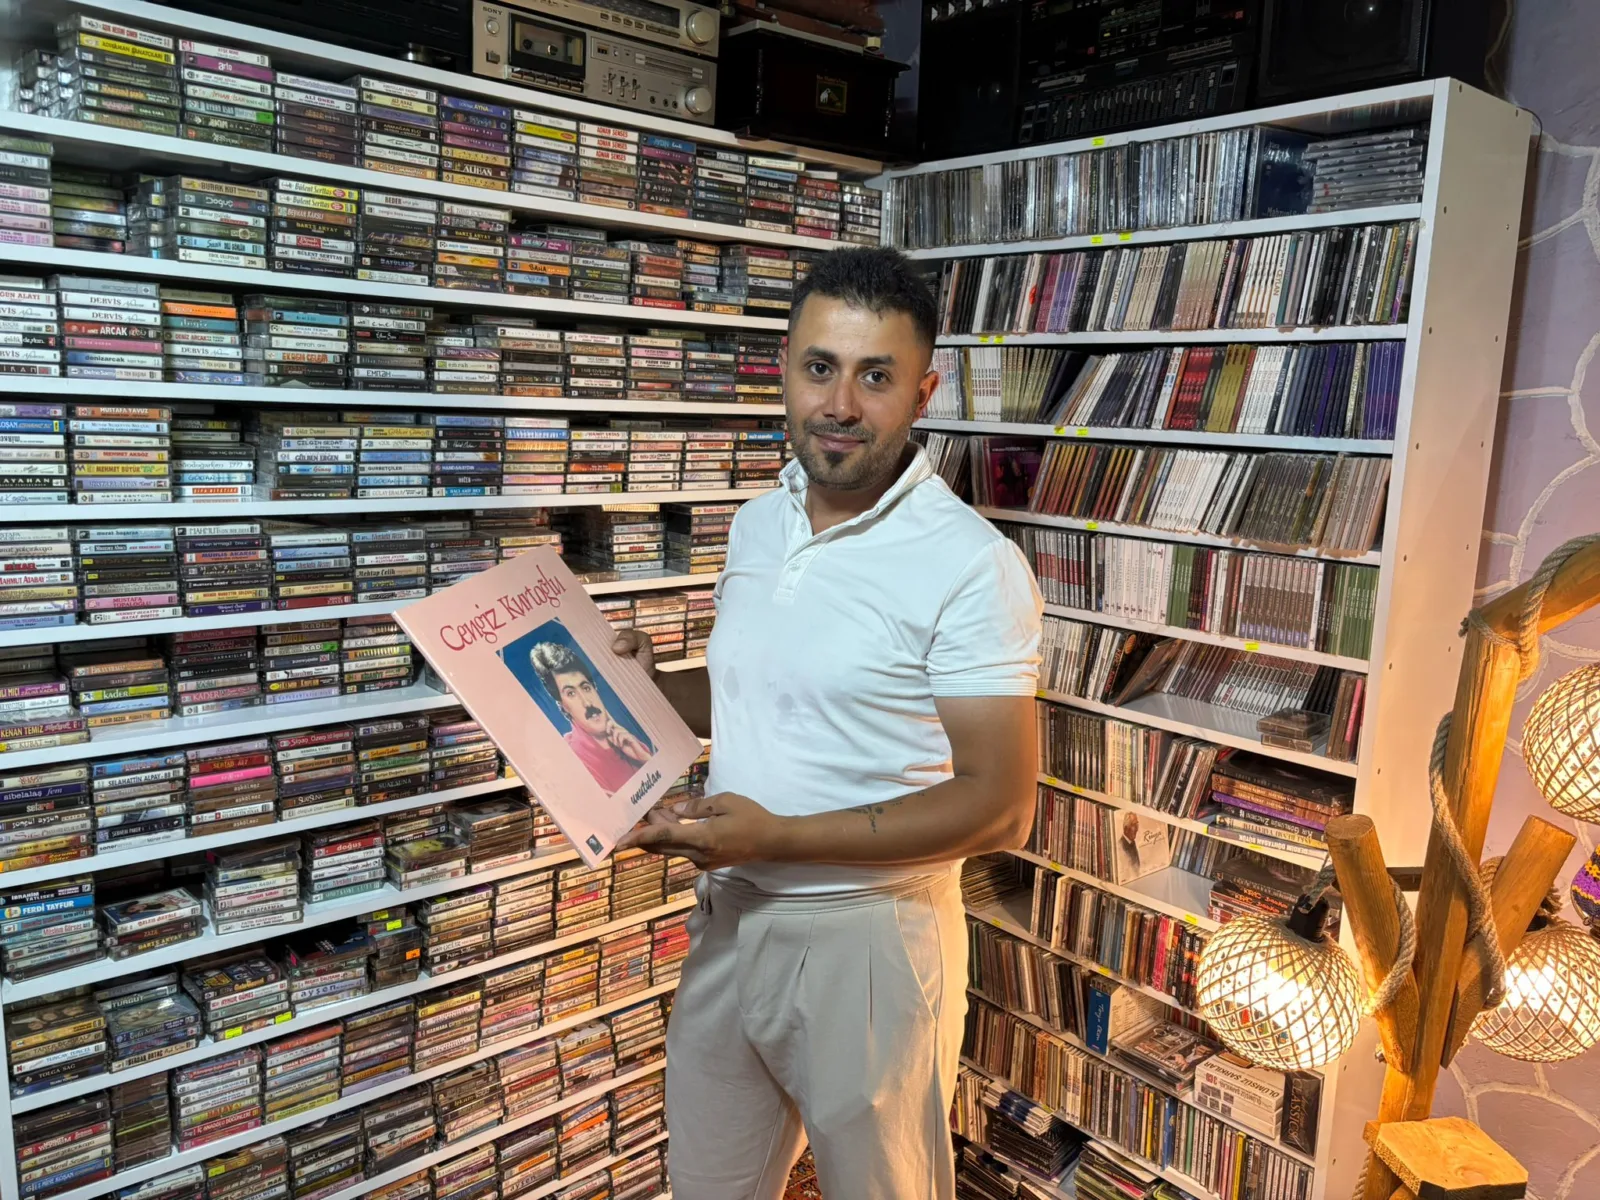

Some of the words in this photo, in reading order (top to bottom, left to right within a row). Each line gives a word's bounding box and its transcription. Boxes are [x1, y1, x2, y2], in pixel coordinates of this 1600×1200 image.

[482, 6, 503, 16] SONY
[596, 127, 611, 135] ADNAN
[612, 129, 628, 138] SENSES
[596, 139, 611, 147] ADNAN
[611, 141, 627, 150] SENSES
[595, 150, 610, 159] ADNAN
[610, 152, 626, 162] SENSES
[200, 181, 222, 193] BURAK
[1273, 269, 1283, 296] CEYLAN
[100, 325, 127, 336] ARCAK
[96, 465, 120, 474] MEHMET
[440, 604, 507, 651] Cengiz
[497, 564, 566, 621] Kurtoğlu
[0, 728, 23, 737] KENAN
[108, 776, 143, 786] SELAHATTİN
[630, 770, 662, 806] unutulan
[22, 903, 45, 915] FERDİ
[45, 900, 74, 913] TAYFUR
[38, 1068, 61, 1079] TOLGA
[1237, 1077, 1281, 1099] ÖLÜMSÜZ
